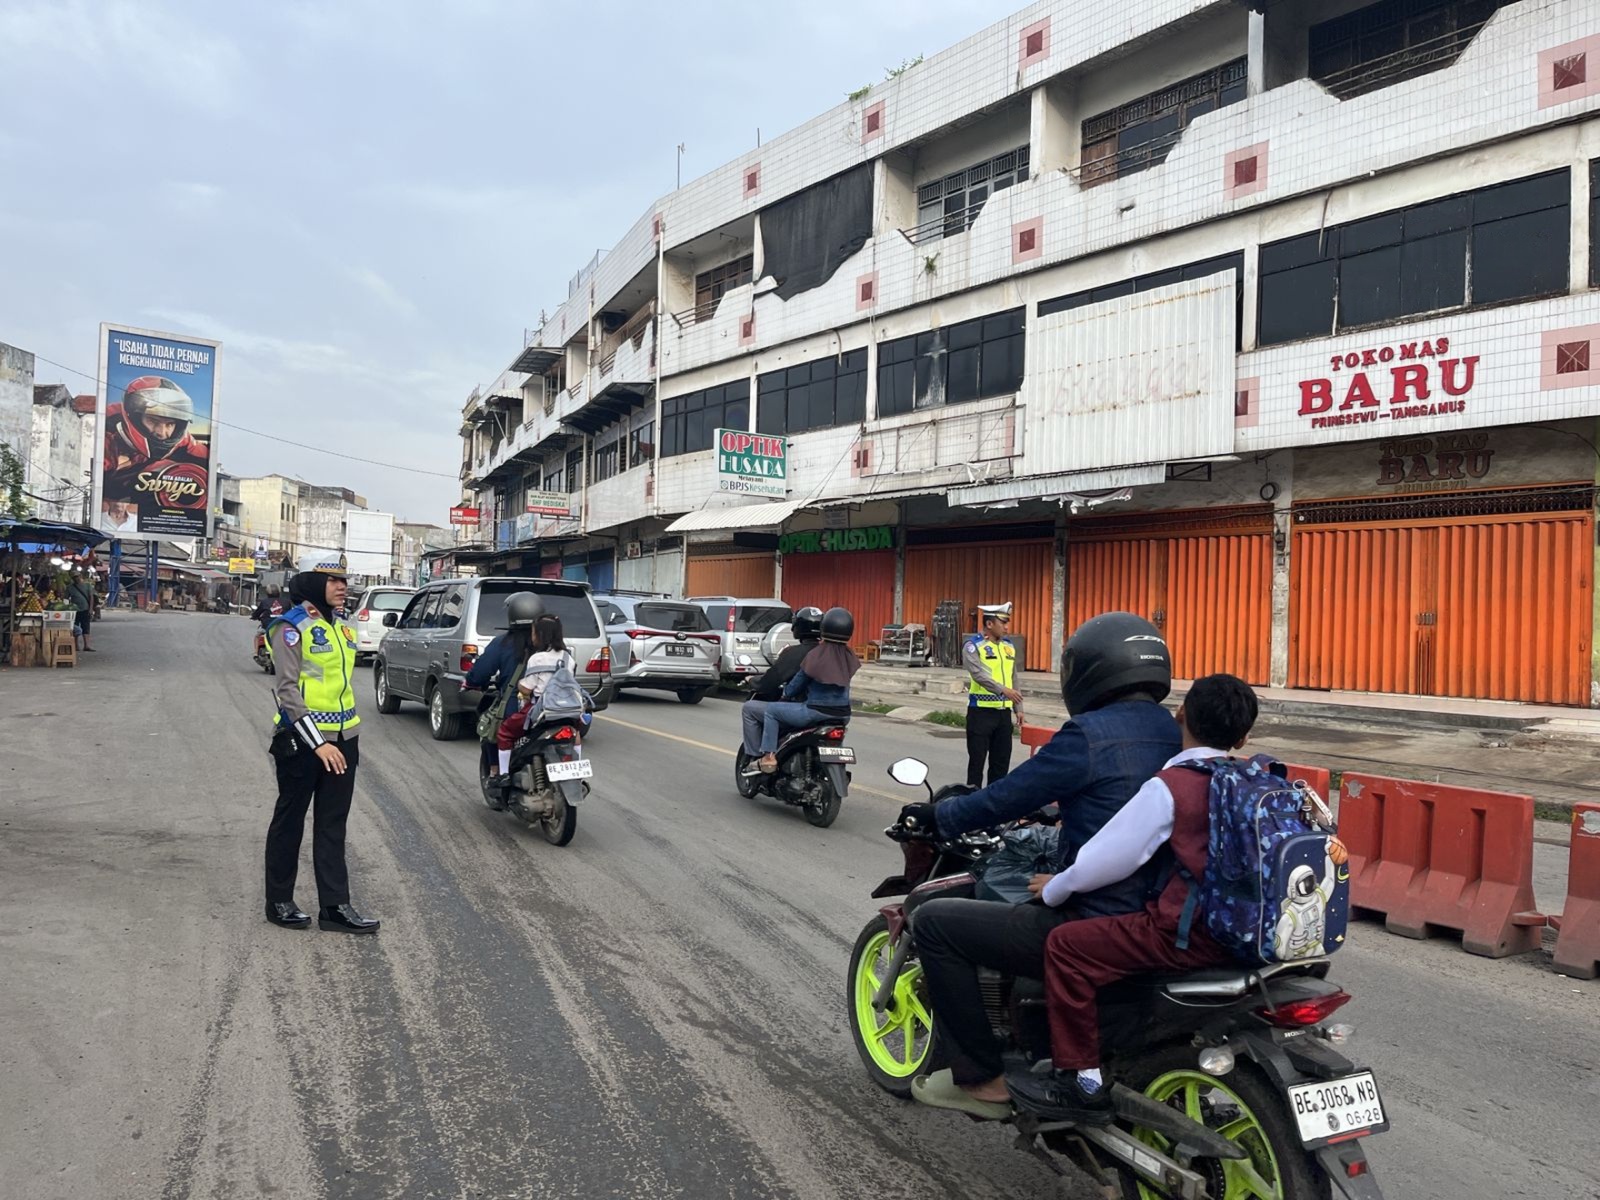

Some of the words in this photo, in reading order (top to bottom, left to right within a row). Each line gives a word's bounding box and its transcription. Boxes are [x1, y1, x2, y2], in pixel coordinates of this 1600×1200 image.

[120, 353, 172, 371] MENGKHIANATI
[151, 344, 175, 359] TIDAK
[177, 348, 209, 364] PERNAH
[1331, 347, 1394, 371] TOKO
[1399, 337, 1449, 360] MAS
[1298, 356, 1480, 416] BARU
[721, 432, 784, 458] OPTIK
[1380, 438, 1432, 458] TOKO
[1436, 433, 1489, 452] MAS
[720, 454, 784, 477] HUSADA
[1376, 450, 1495, 485] BARU
[135, 472, 205, 502] Surya
[729, 481, 750, 491] BPJS
[750, 484, 784, 495] Kesehatan
[779, 531, 822, 554] OPTIK
[827, 526, 893, 552] HUSADA
[1294, 1091, 1313, 1115] BE
[1316, 1085, 1350, 1110] 3068
[1356, 1080, 1375, 1103] NB
